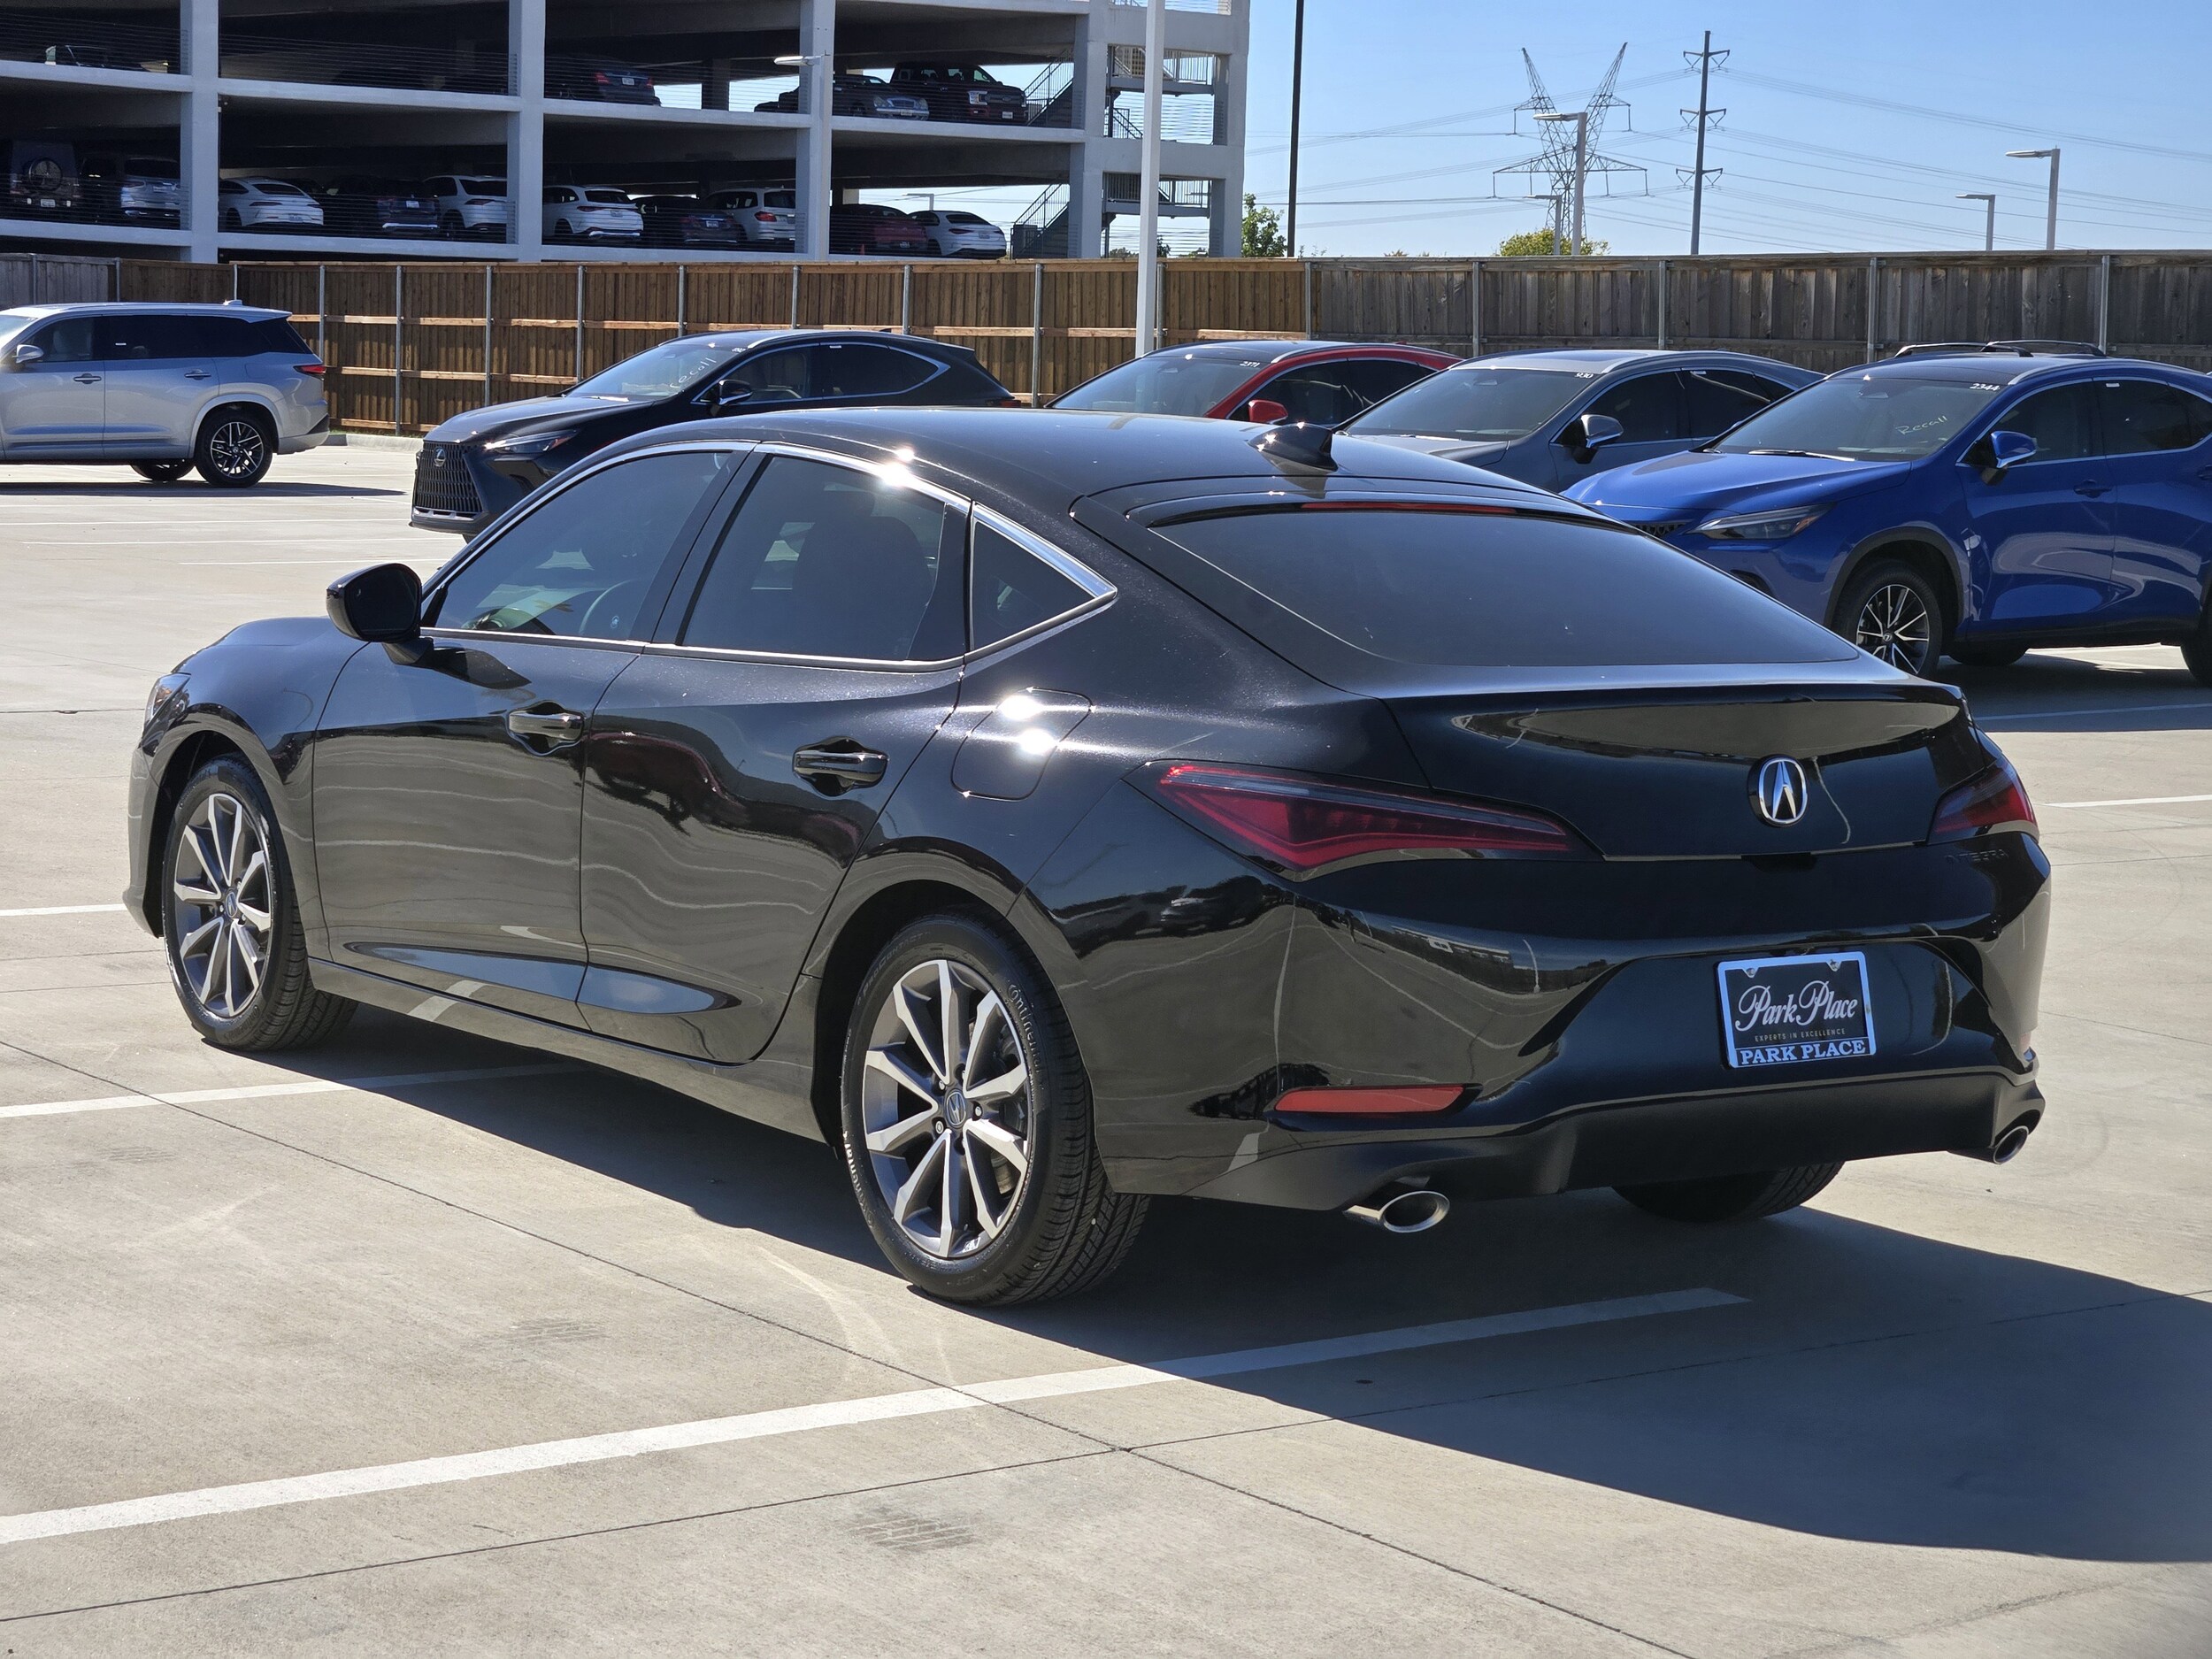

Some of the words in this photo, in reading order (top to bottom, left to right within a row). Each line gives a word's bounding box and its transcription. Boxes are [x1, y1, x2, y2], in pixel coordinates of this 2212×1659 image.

[1894, 415, 1947, 436] Recall
[1735, 985, 1798, 1032] Park
[1795, 979, 1858, 1026] Place
[1755, 1033, 1786, 1042] EXPERTS
[1789, 1031, 1798, 1040] IN
[1801, 1028, 1846, 1039] EXCELLENCE
[1740, 1045, 1797, 1065] PARK
[1801, 1039, 1866, 1059] PLACE
